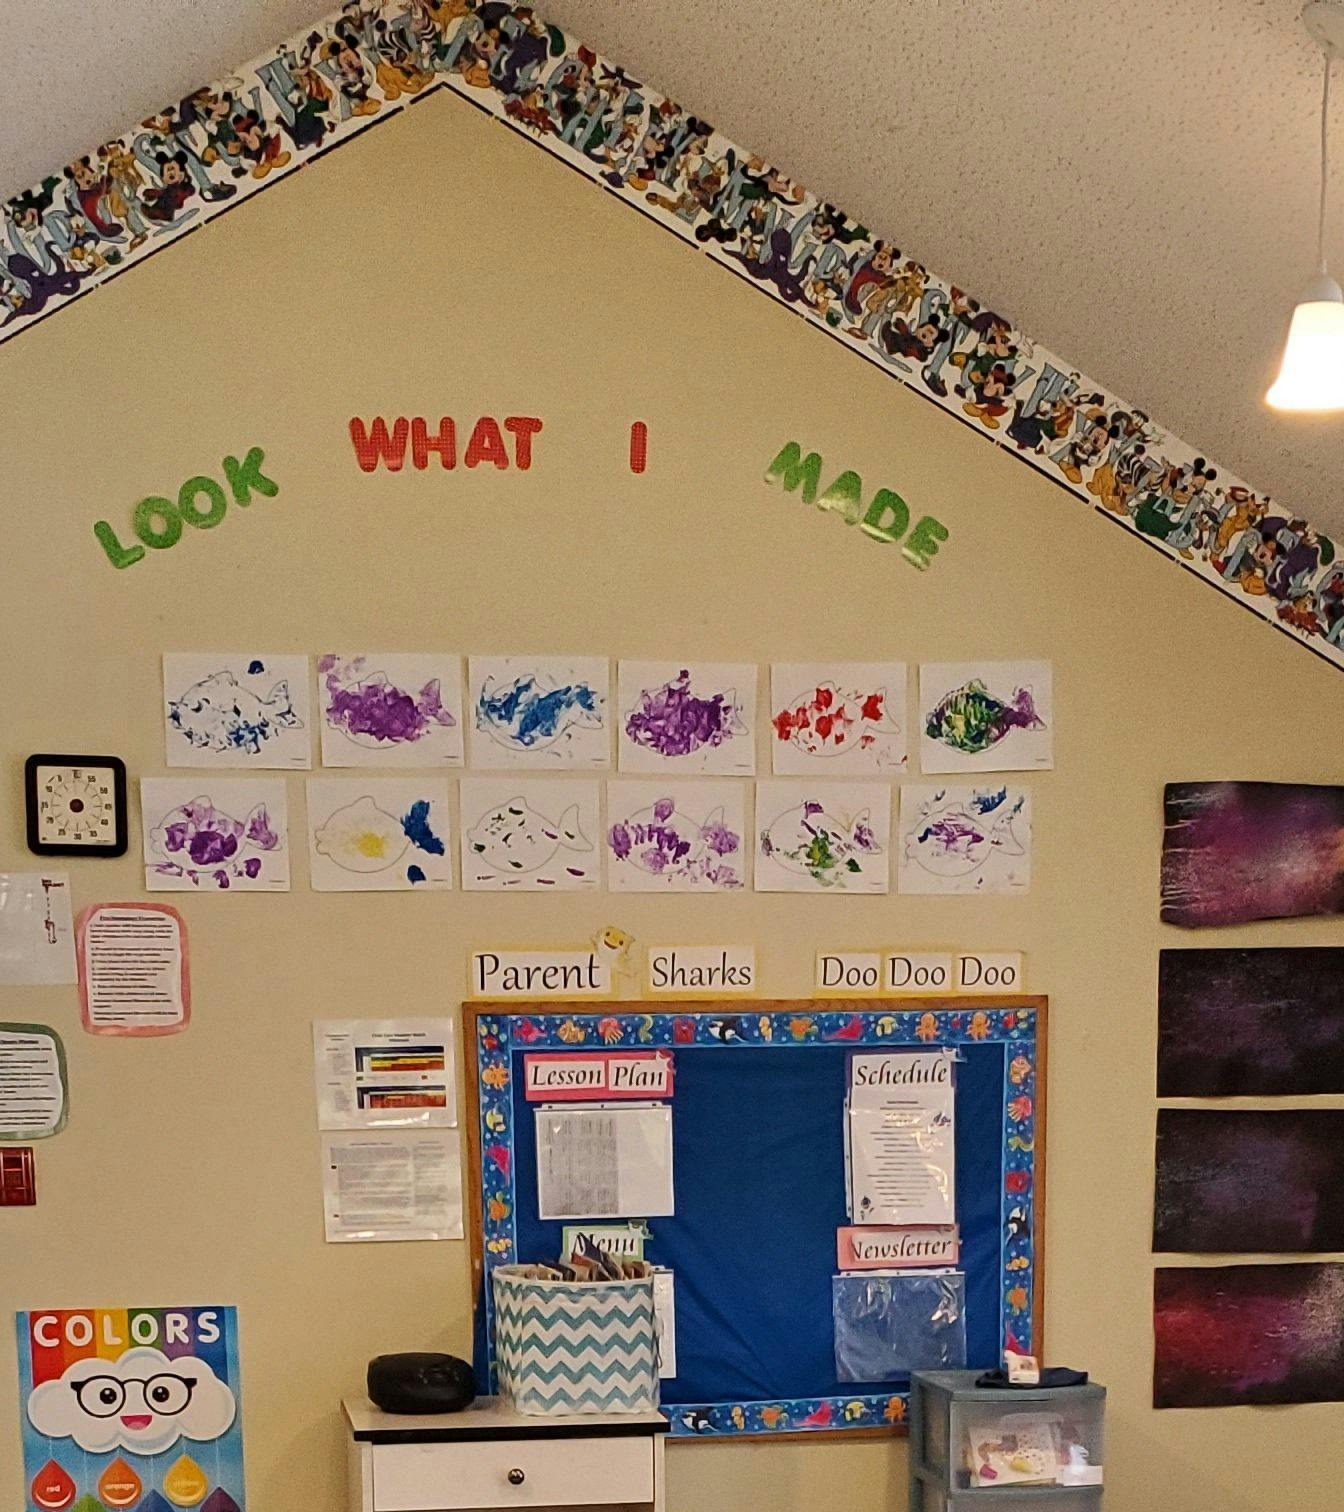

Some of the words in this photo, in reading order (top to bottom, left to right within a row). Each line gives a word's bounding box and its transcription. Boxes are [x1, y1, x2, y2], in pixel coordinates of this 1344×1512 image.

[93, 447, 279, 569] LOOK
[349, 415, 542, 473] WHAT
[630, 421, 648, 473] I
[763, 441, 949, 571] MADE
[474, 952, 601, 992] Parent
[652, 955, 752, 990] Sharks
[821, 957, 878, 988] Doo
[889, 957, 946, 988] Doo
[959, 956, 1017, 987] Doo
[532, 1065, 602, 1086] Lesson
[613, 1062, 663, 1087] Plan
[855, 1059, 947, 1086] Schedule
[852, 1235, 951, 1260] Newsletter
[33, 1311, 220, 1348] COLORS
[46, 1484, 61, 1493] red
